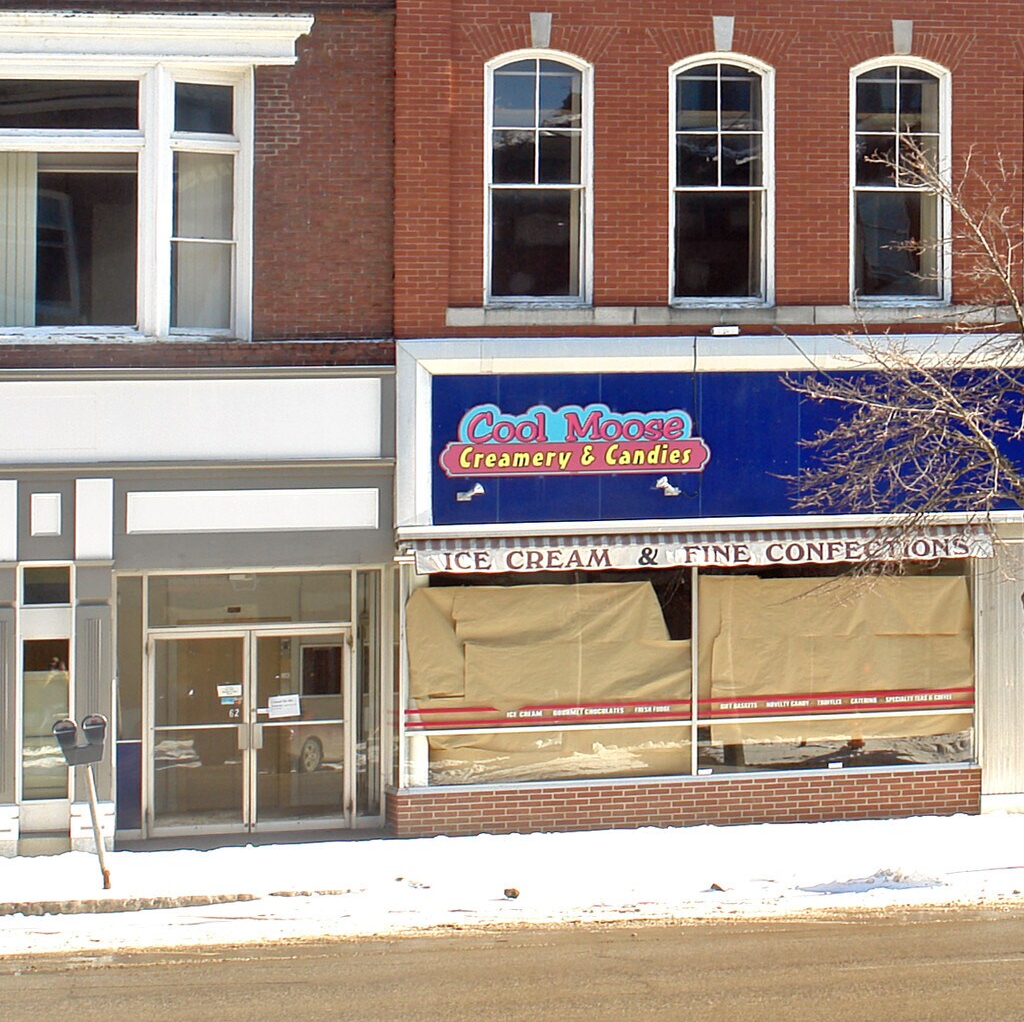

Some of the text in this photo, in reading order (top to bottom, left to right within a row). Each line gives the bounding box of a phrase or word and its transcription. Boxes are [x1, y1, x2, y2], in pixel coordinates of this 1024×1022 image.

[466, 411, 685, 444] Cool Moose
[459, 444, 692, 470] Creamery & Candies
[443, 551, 492, 571] ICE
[506, 549, 613, 570] CREAM
[638, 547, 659, 566] &
[684, 544, 752, 563] FINE
[229, 709, 240, 717] 62
[519, 710, 543, 718] CREAM
